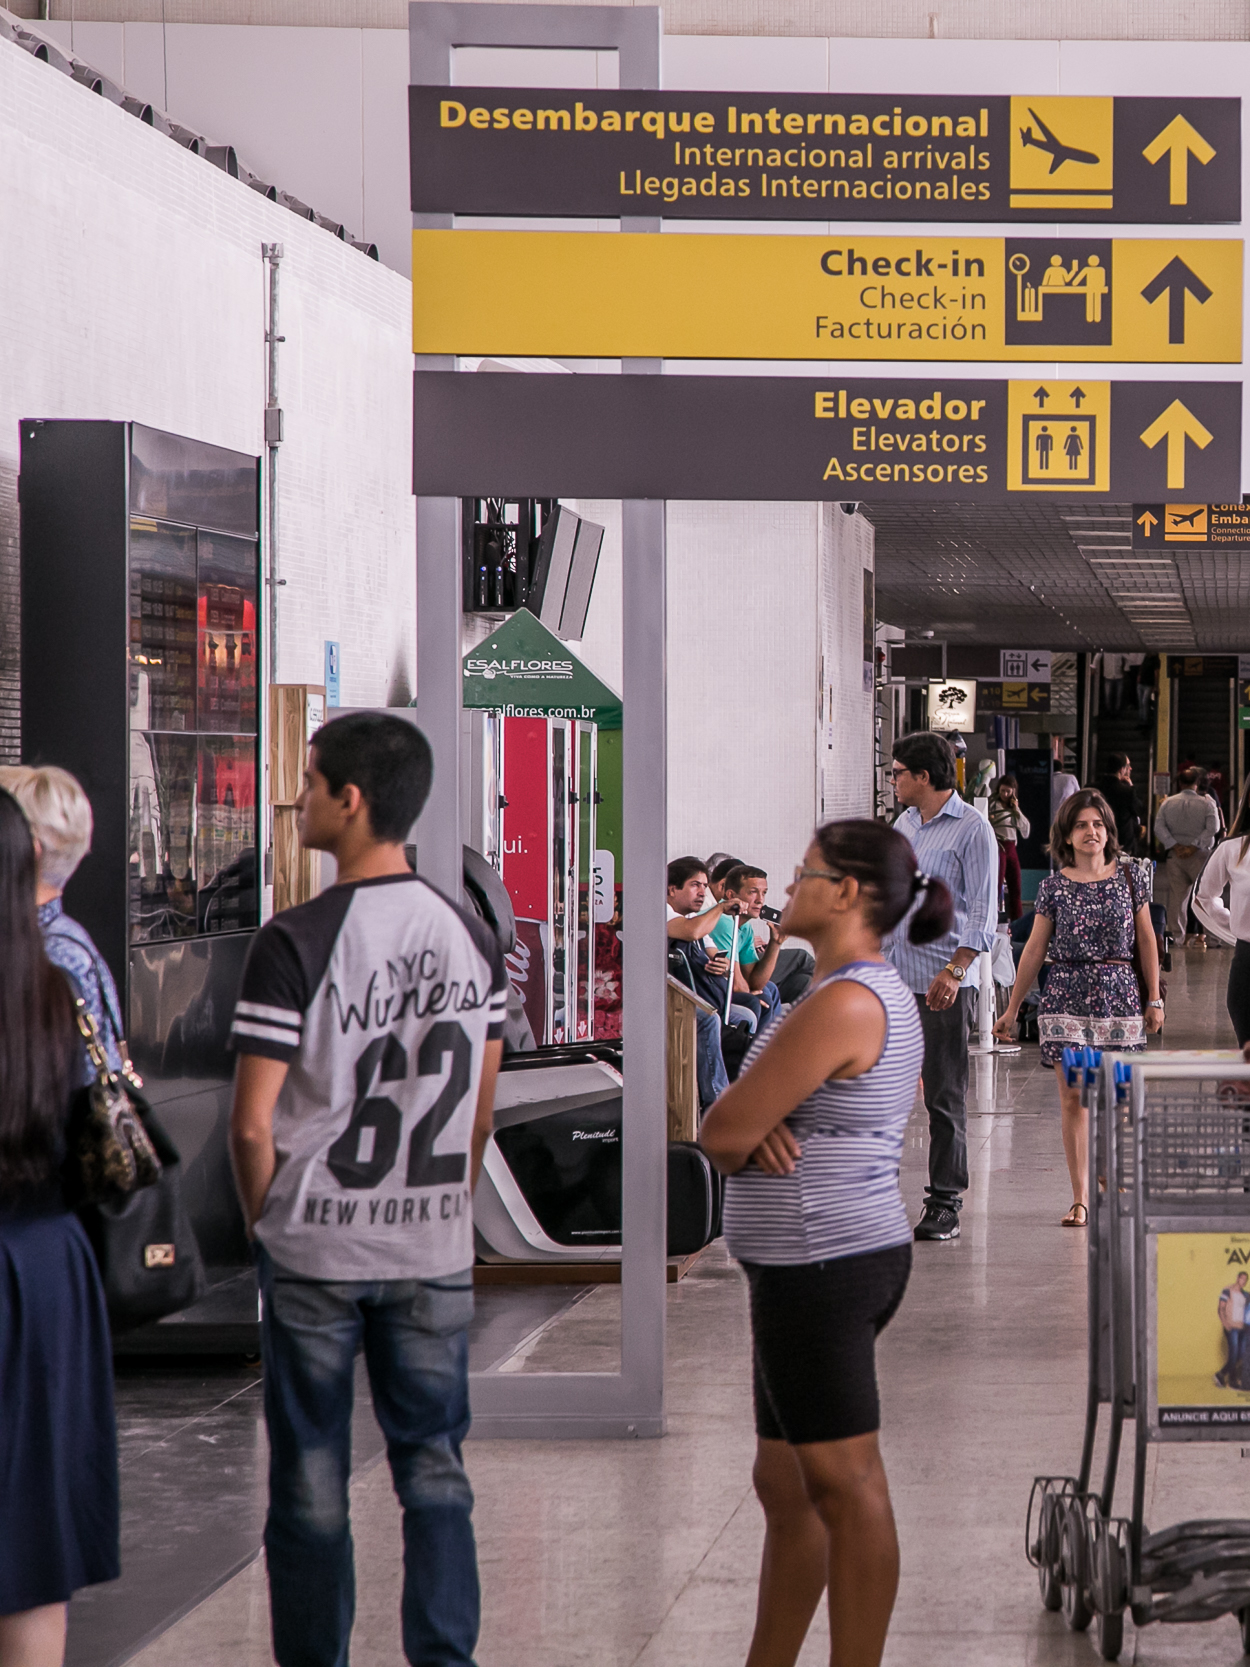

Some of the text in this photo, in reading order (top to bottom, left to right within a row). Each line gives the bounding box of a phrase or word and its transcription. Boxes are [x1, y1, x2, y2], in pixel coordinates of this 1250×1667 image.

[440, 100, 989, 139] Desembarque Internacional
[675, 141, 991, 170] Internacional arrivals
[620, 170, 991, 202] Llegadas Internacionales
[820, 248, 985, 278] Check-in
[859, 284, 986, 311] Check-in
[815, 314, 987, 341] Facturación
[814, 390, 986, 420] Elevador
[852, 425, 987, 453] Elevators
[822, 456, 989, 483] Ascensores
[467, 659, 574, 671] ESALFLORES
[386, 949, 438, 989] NYC
[326, 1019, 473, 1190] 62
[303, 1198, 358, 1227] NEW
[368, 1196, 432, 1226] YORK
[1162, 1411, 1209, 1423] ANUNCIE
[1212, 1411, 1239, 1422] AQUI
